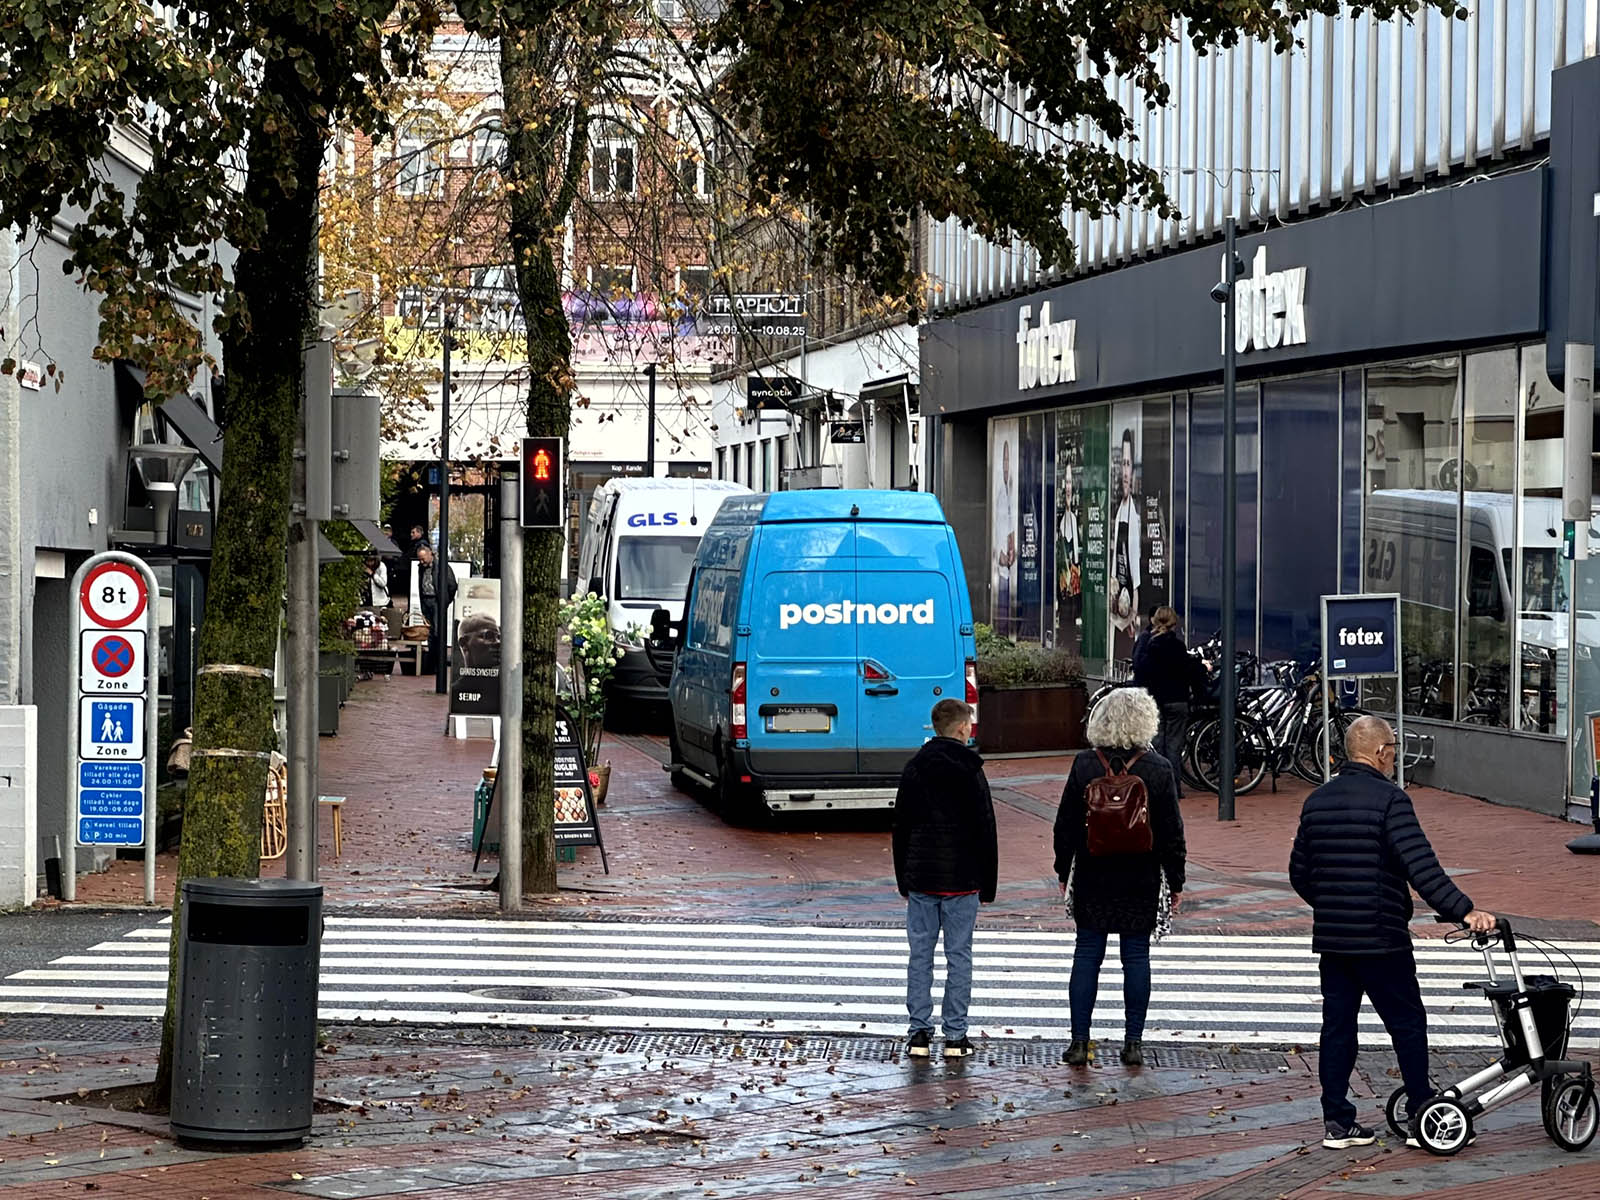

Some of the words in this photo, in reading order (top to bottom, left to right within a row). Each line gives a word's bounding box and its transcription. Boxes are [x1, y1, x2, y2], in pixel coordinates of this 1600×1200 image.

[713, 298, 800, 313] TRAPHOLT
[1016, 301, 1077, 390] føtex
[627, 512, 679, 528] GLS
[779, 599, 934, 629] postnord
[1339, 627, 1384, 645] føtex
[476, 668, 499, 678] SYNSTEST
[97, 680, 129, 690] Zone
[97, 702, 128, 711] Gågade
[96, 746, 128, 756] Zone
